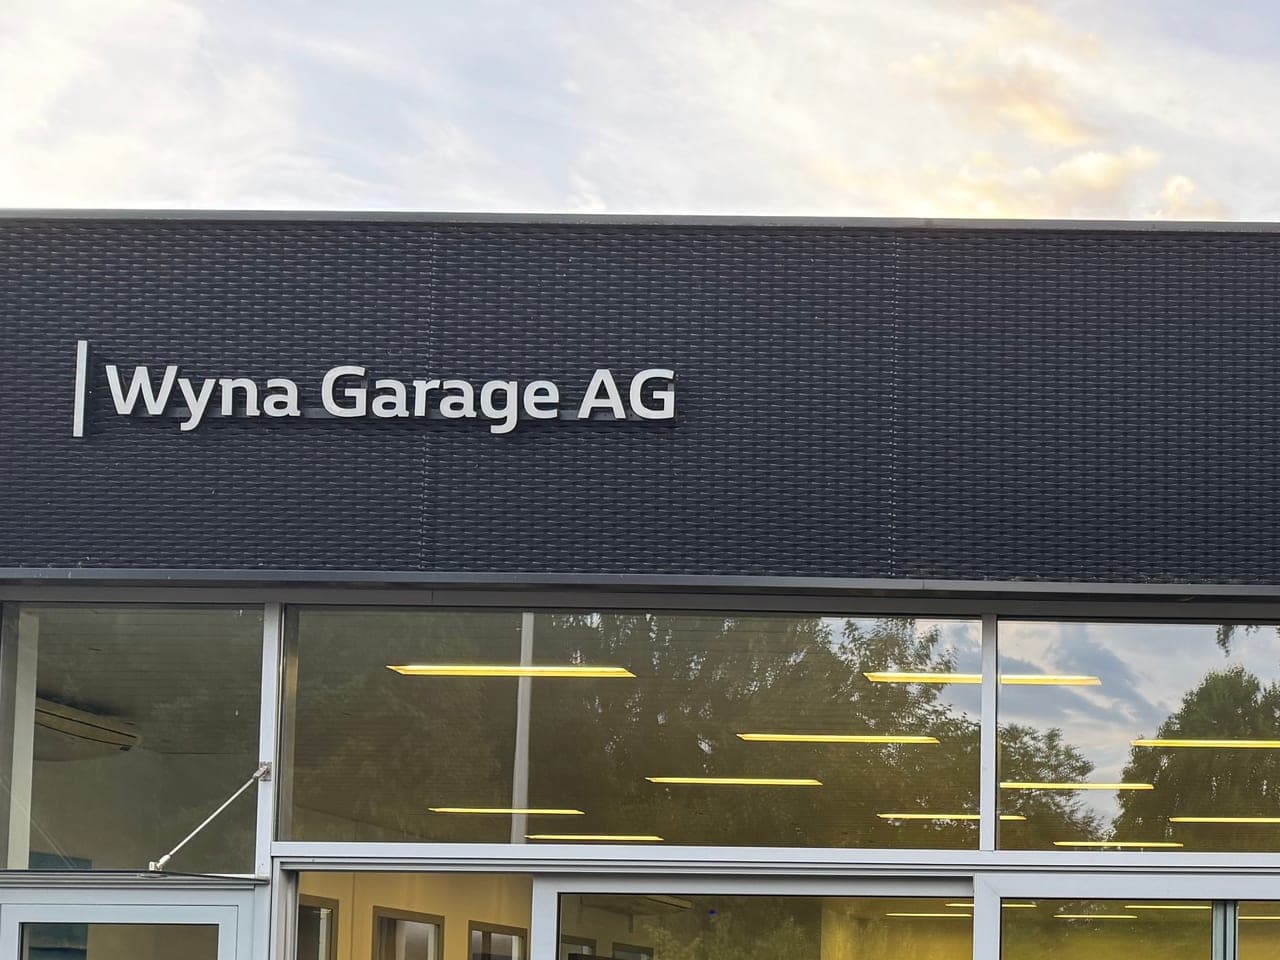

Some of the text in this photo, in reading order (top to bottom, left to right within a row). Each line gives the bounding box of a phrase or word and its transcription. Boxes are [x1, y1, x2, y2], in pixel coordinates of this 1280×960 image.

[105, 364, 675, 434] Wyna Garage AG
